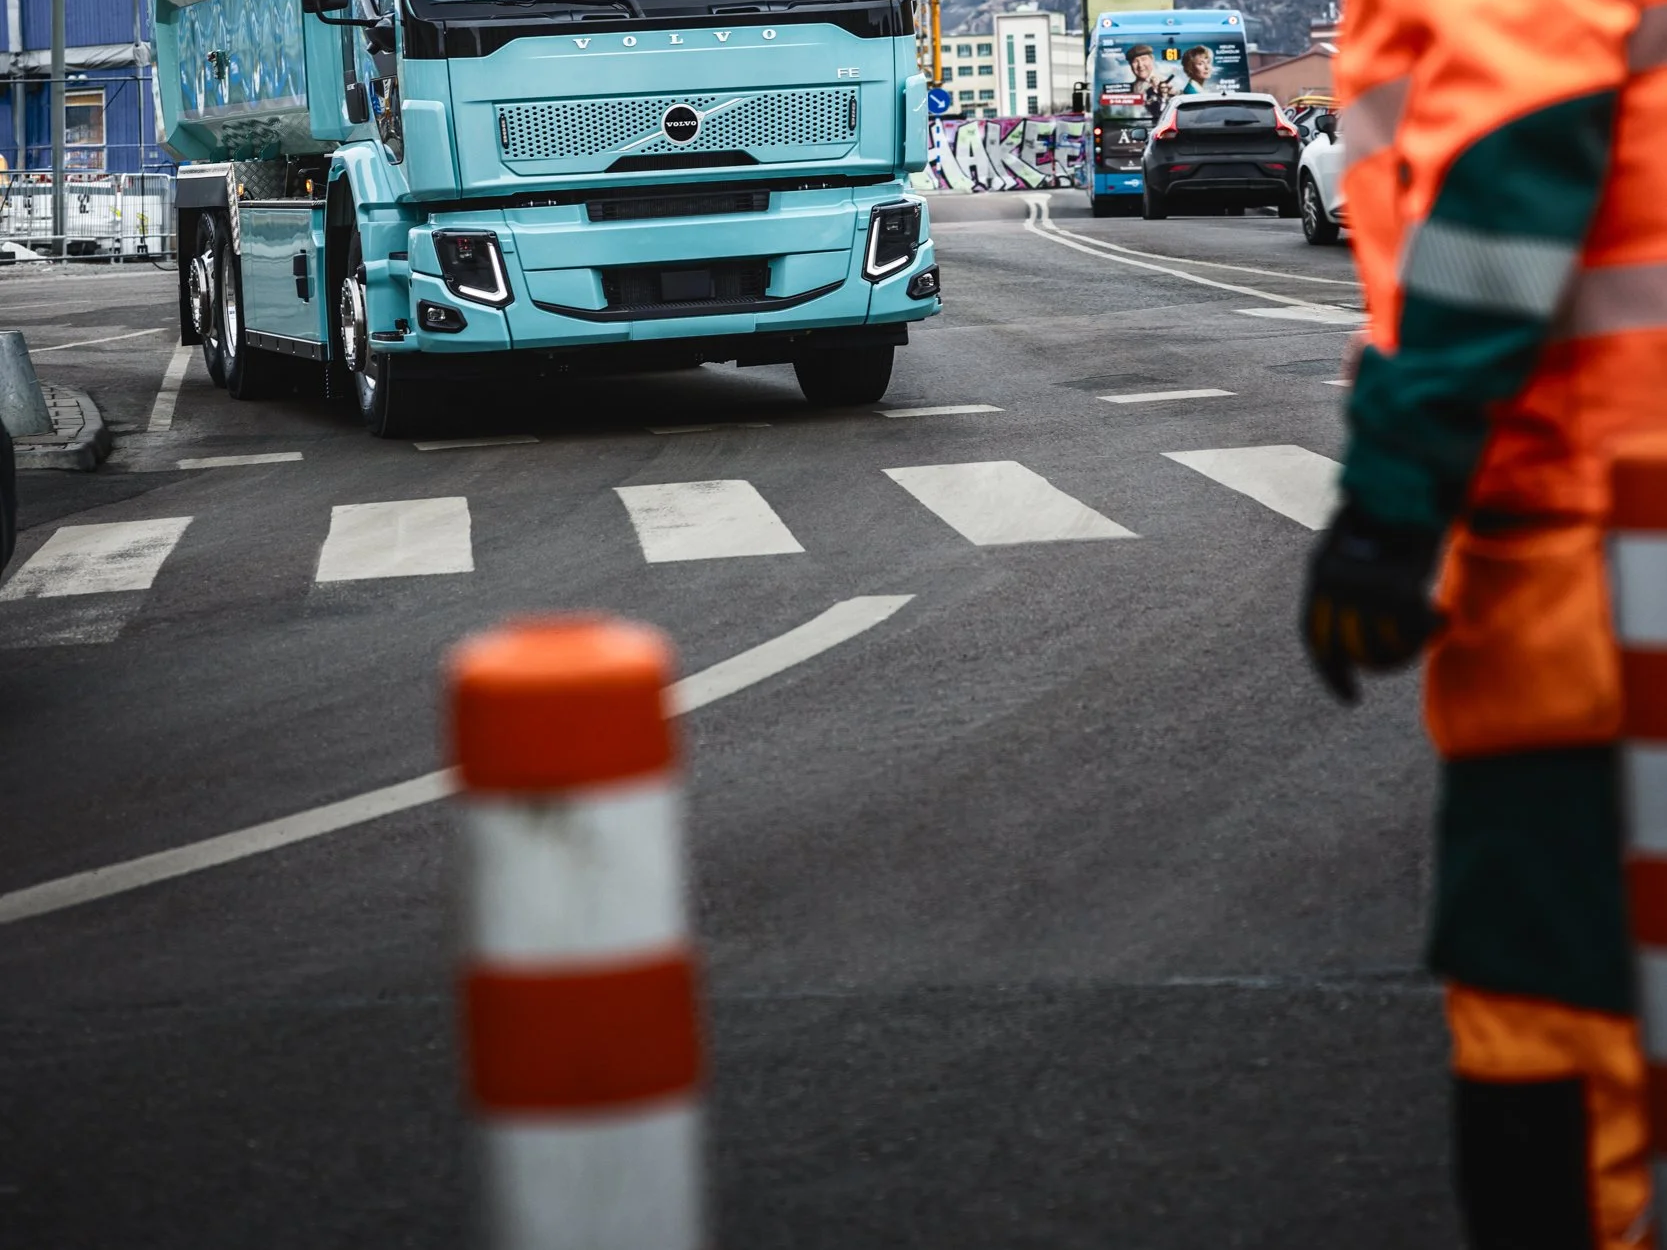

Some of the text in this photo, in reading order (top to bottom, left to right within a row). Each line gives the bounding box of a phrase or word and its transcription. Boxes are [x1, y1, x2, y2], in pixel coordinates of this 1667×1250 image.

[573, 29, 776, 49] VOLVO
[1166, 48, 1178, 61] 61
[837, 67, 860, 79] FE
